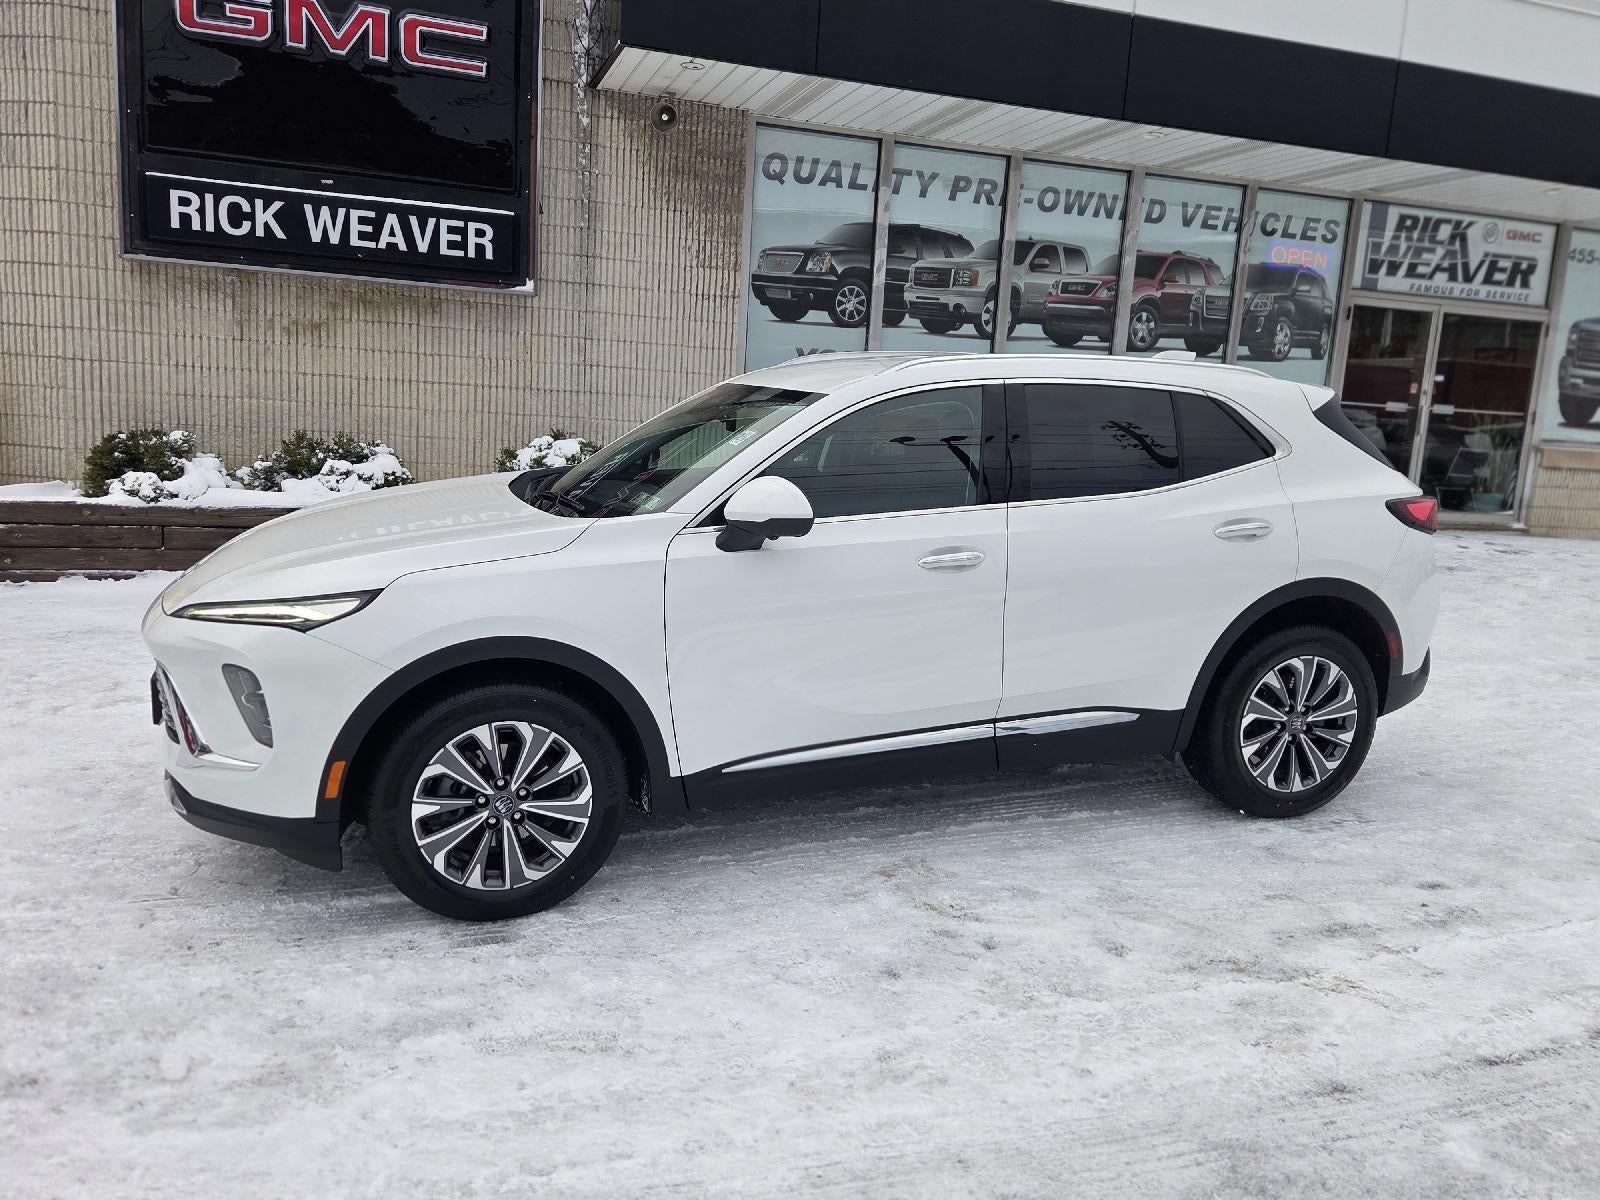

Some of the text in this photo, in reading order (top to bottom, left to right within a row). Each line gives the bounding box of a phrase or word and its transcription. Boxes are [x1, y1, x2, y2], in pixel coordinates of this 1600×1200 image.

[174, 0, 488, 77] GMC
[169, 188, 494, 260] RICK WEAVER
[761, 152, 940, 199] QUALTY
[947, 175, 1168, 225] PR-OWND
[1271, 245, 1329, 269] OPEN
[1366, 213, 1539, 289] RICK WEAVER
[1505, 228, 1544, 244] GMC
[1409, 282, 1532, 303] FAMOUS FOR SERVICE
